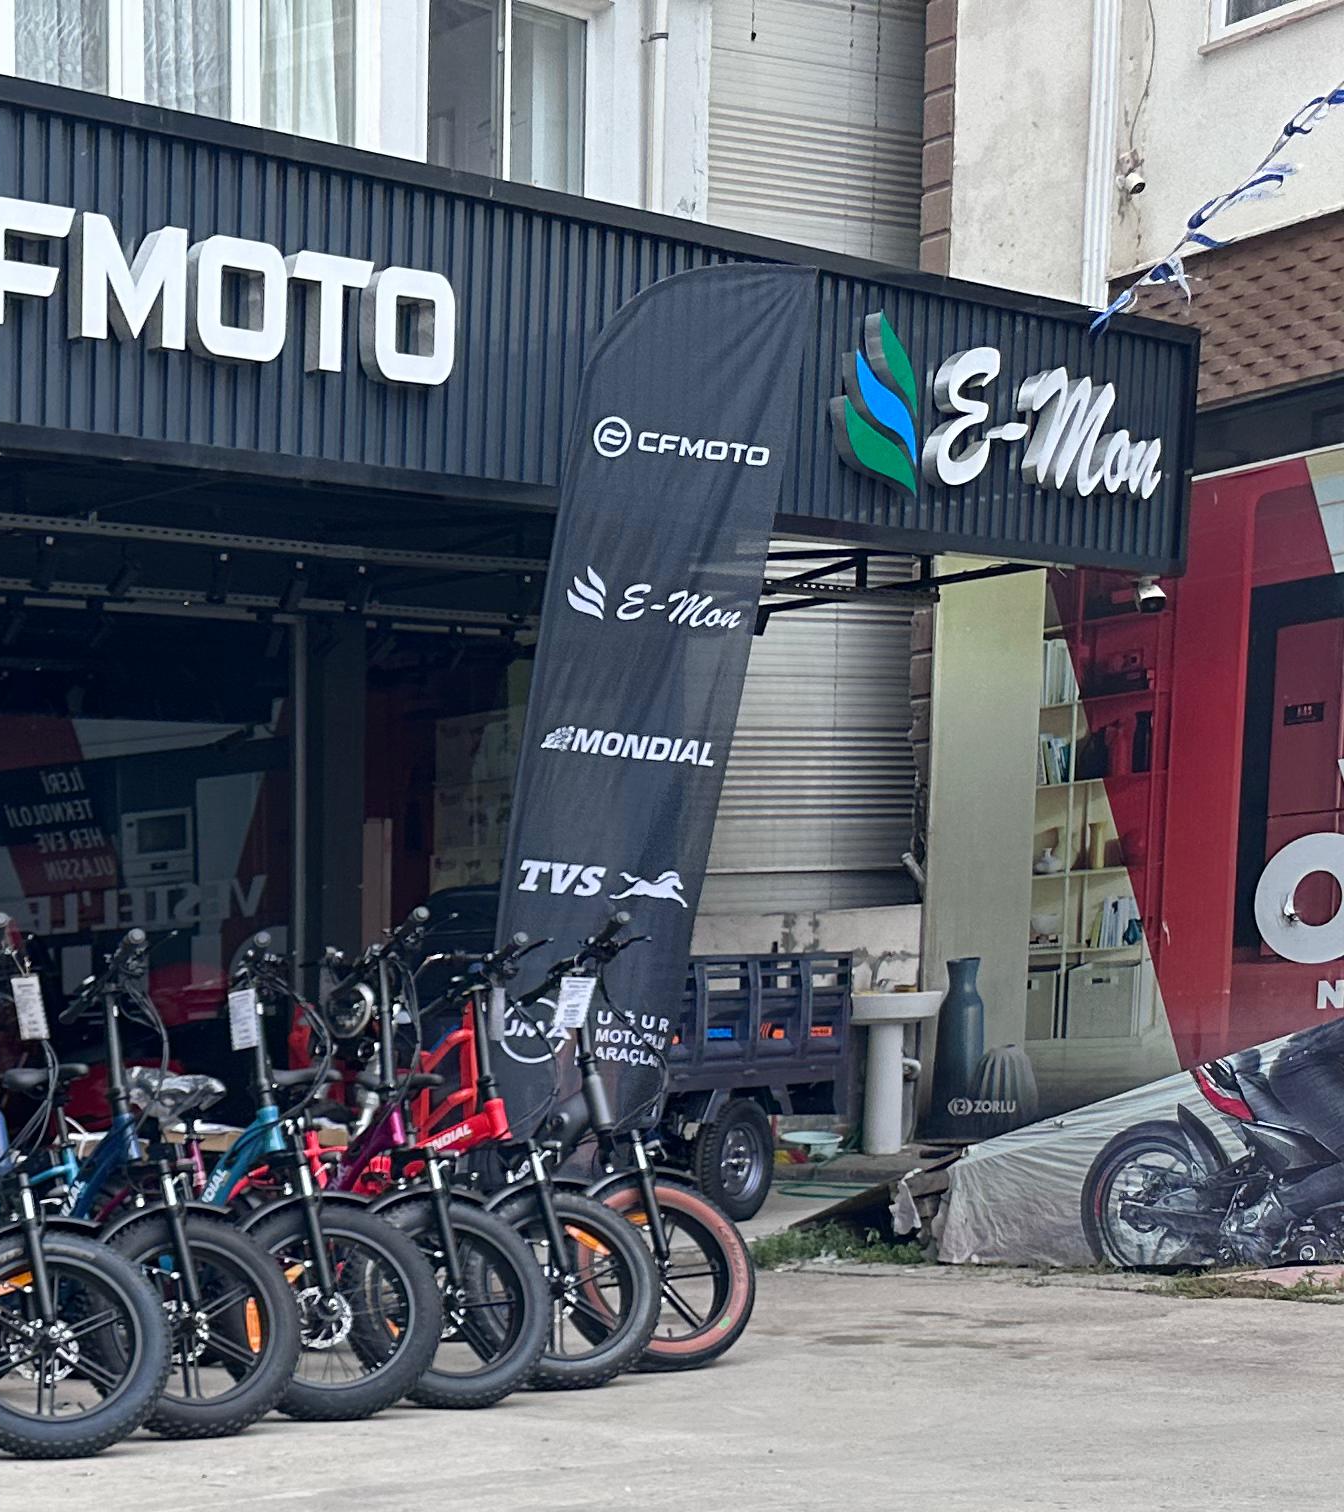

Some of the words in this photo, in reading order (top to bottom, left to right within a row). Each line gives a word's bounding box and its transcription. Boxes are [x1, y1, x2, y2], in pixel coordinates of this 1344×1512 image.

[924, 346, 1162, 500] E-Mon
[637, 431, 770, 466] CFMOTO
[615, 583, 742, 629] E-Mon
[571, 727, 714, 767] MONDIAL
[518, 859, 607, 896] TVS
[595, 1046, 660, 1069] ARAÇLA
[973, 1100, 1017, 1114] ZORLU
